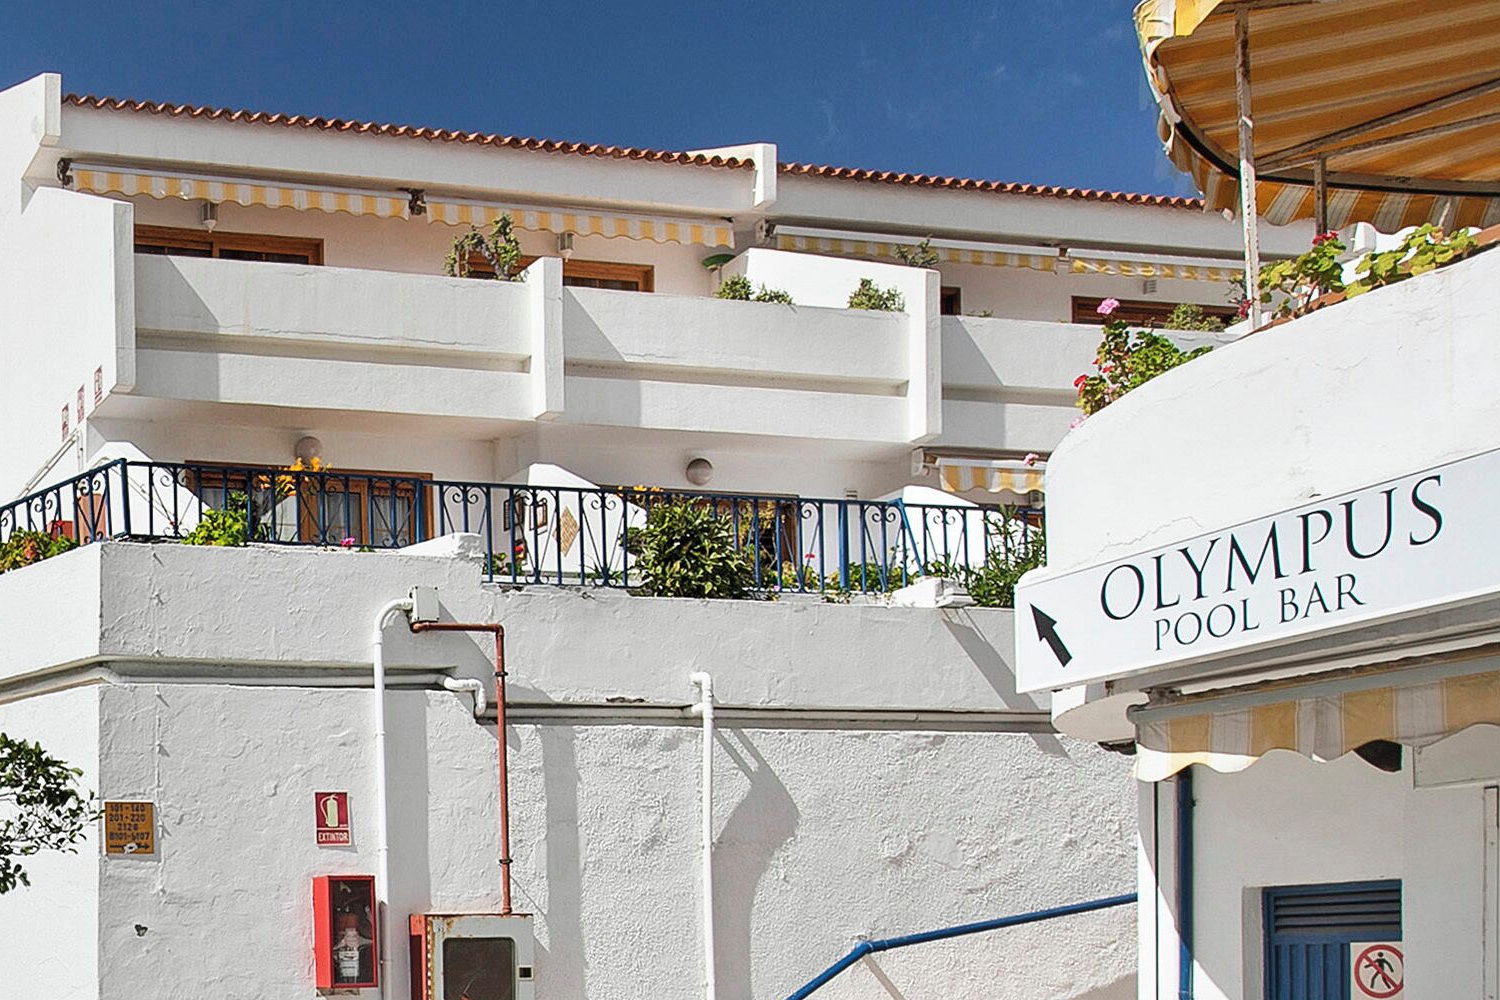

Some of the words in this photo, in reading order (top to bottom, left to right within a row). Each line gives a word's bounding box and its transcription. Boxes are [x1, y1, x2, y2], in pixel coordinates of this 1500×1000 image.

[1100, 474, 1443, 621] OLYMPUS
[1154, 598, 1260, 651] POOL
[1278, 573, 1368, 625] BAR
[109, 813, 123, 822] 201
[318, 832, 349, 841] EXTINTOR
